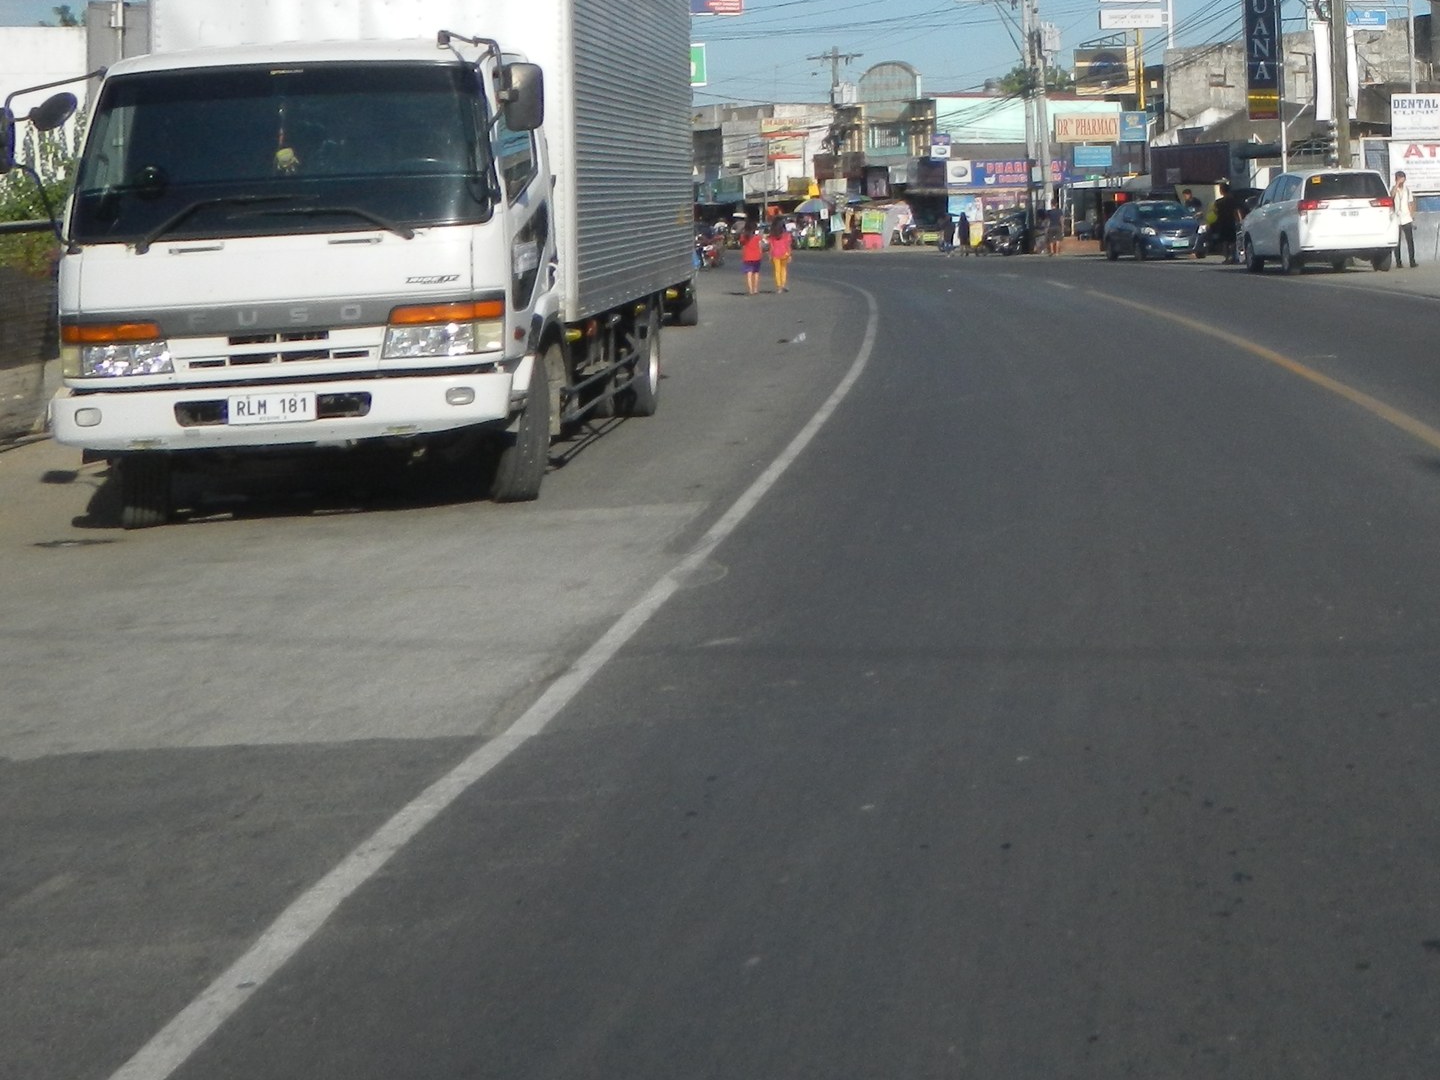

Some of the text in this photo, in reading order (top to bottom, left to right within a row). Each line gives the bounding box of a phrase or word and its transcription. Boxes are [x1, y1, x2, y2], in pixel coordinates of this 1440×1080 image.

[1393, 99, 1439, 109] DENTAL
[1075, 118, 1119, 136] PHARMACY
[188, 304, 362, 331] FUSO
[236, 397, 308, 416] RLM 181
